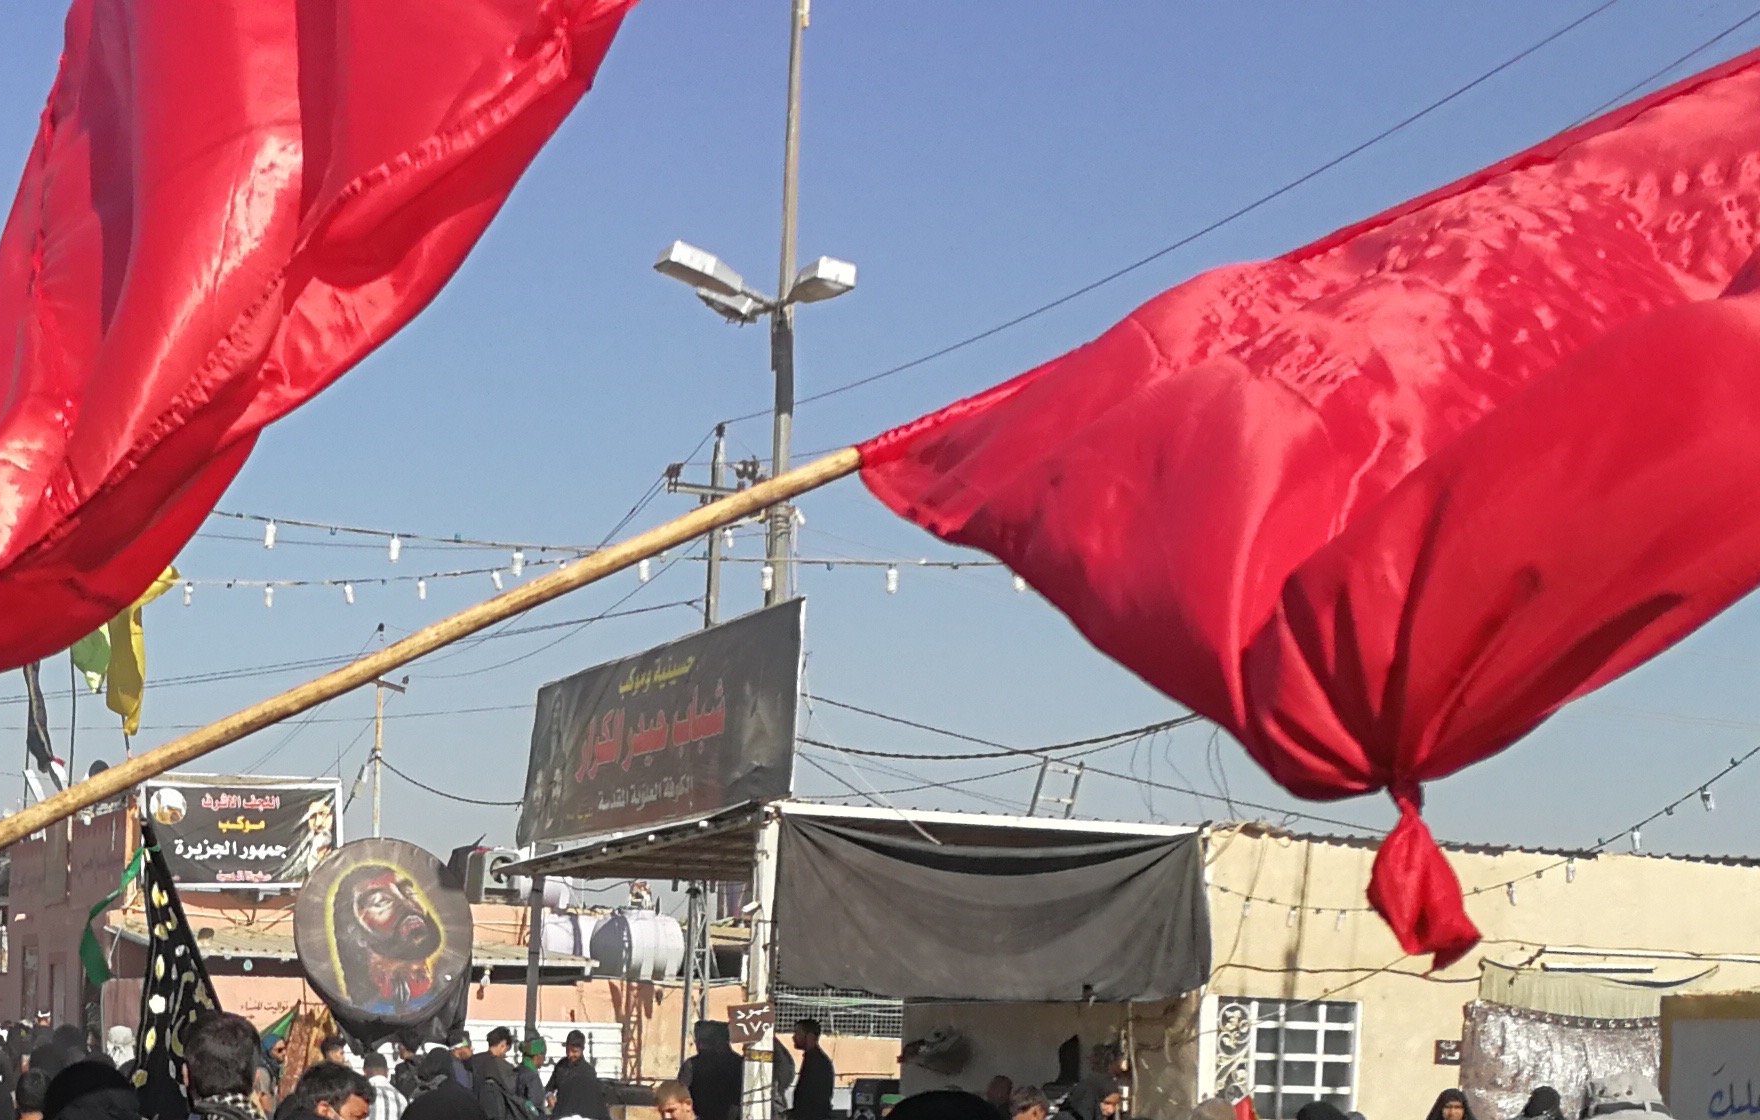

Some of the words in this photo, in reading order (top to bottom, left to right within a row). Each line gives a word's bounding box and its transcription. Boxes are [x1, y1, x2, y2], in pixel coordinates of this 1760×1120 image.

[672, 678, 726, 755] شباب
[575, 706, 626, 783] الكرار
[621, 709, 669, 773] حيدر
[243, 793, 281, 812] النجف
[218, 815, 266, 834] موكب
[174, 839, 238, 861] الجزيرة
[239, 843, 288, 861] جمهور
[736, 1005, 771, 1020] عمود
